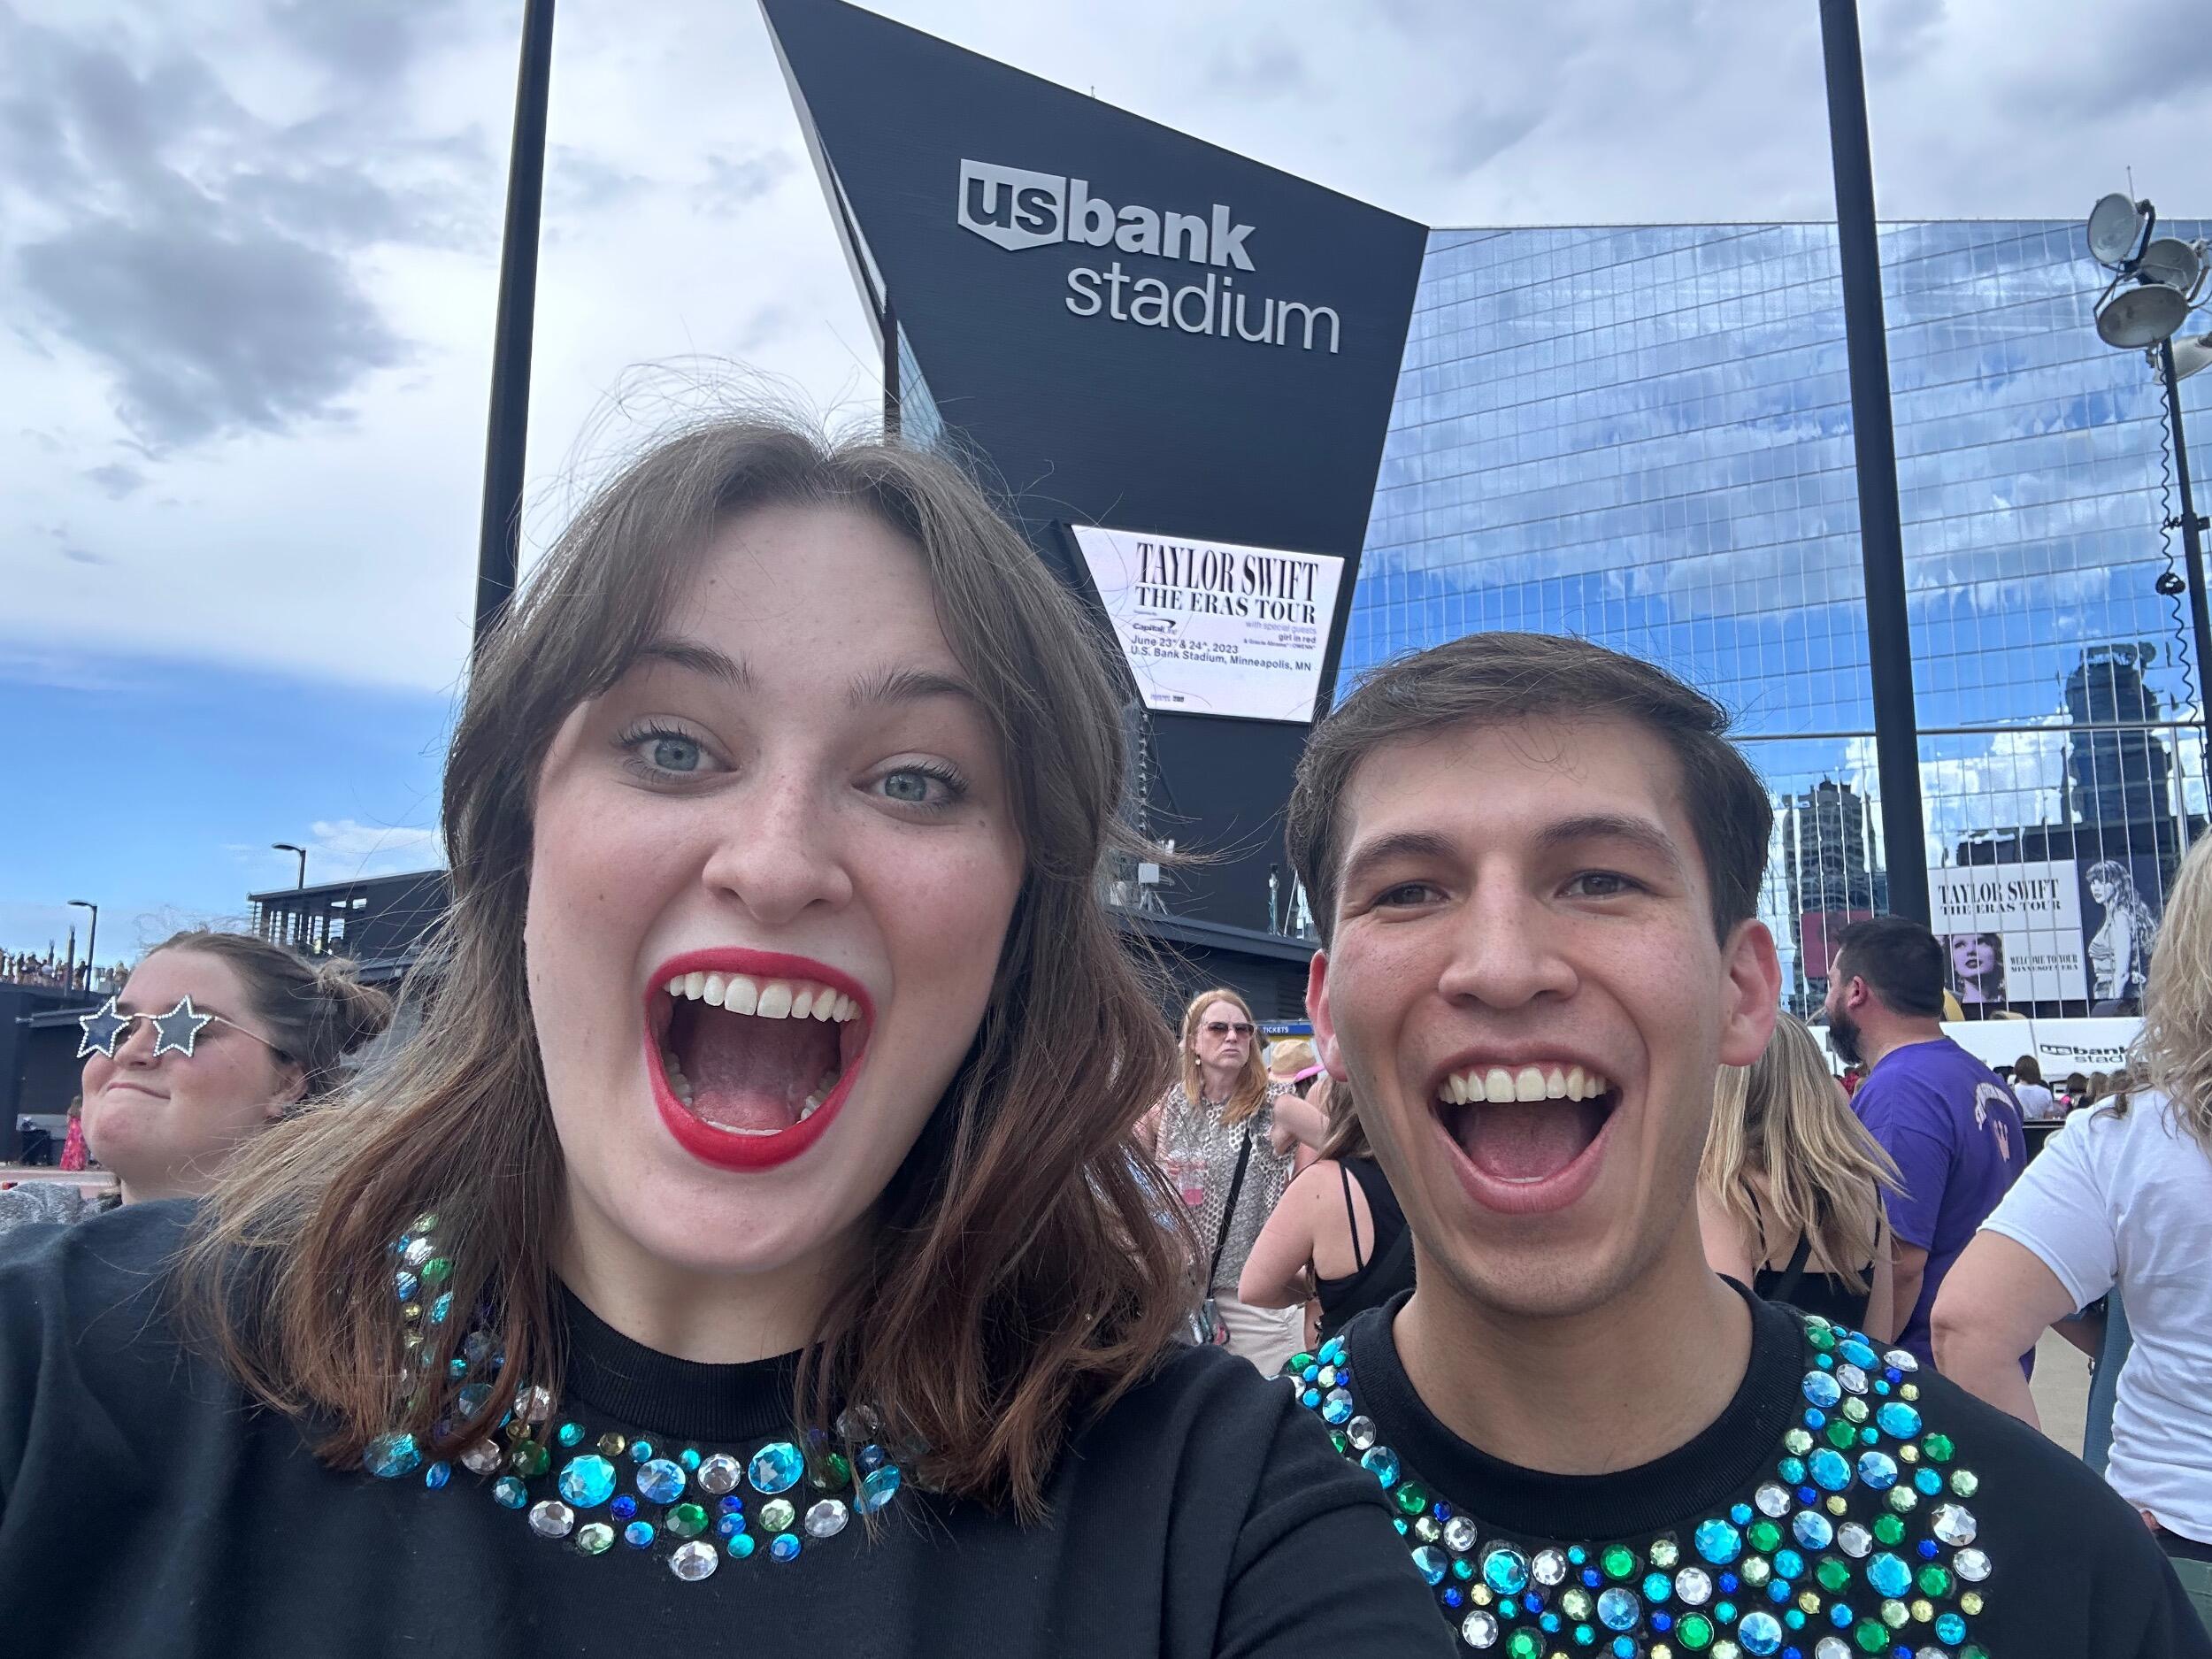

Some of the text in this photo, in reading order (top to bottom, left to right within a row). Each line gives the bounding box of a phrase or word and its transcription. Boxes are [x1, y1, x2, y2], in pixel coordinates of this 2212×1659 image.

[1065, 262, 1340, 353] stadium
[1137, 542, 1318, 602] TAYLOR SWIFT
[1135, 586, 1316, 624] THE ERAS TOUR
[1132, 635, 1156, 647] June
[1179, 640, 1187, 649] &
[1213, 643, 1239, 654] 2023
[1302, 635, 1317, 644] red
[1131, 646, 1311, 671] U.S. Bank Stadium, Minneapolis, MN
[1938, 879, 2059, 904] TAYLOR SWIFT
[1940, 901, 2061, 916] THE ERAS TOUR
[2010, 956, 2045, 965] WELCOME
